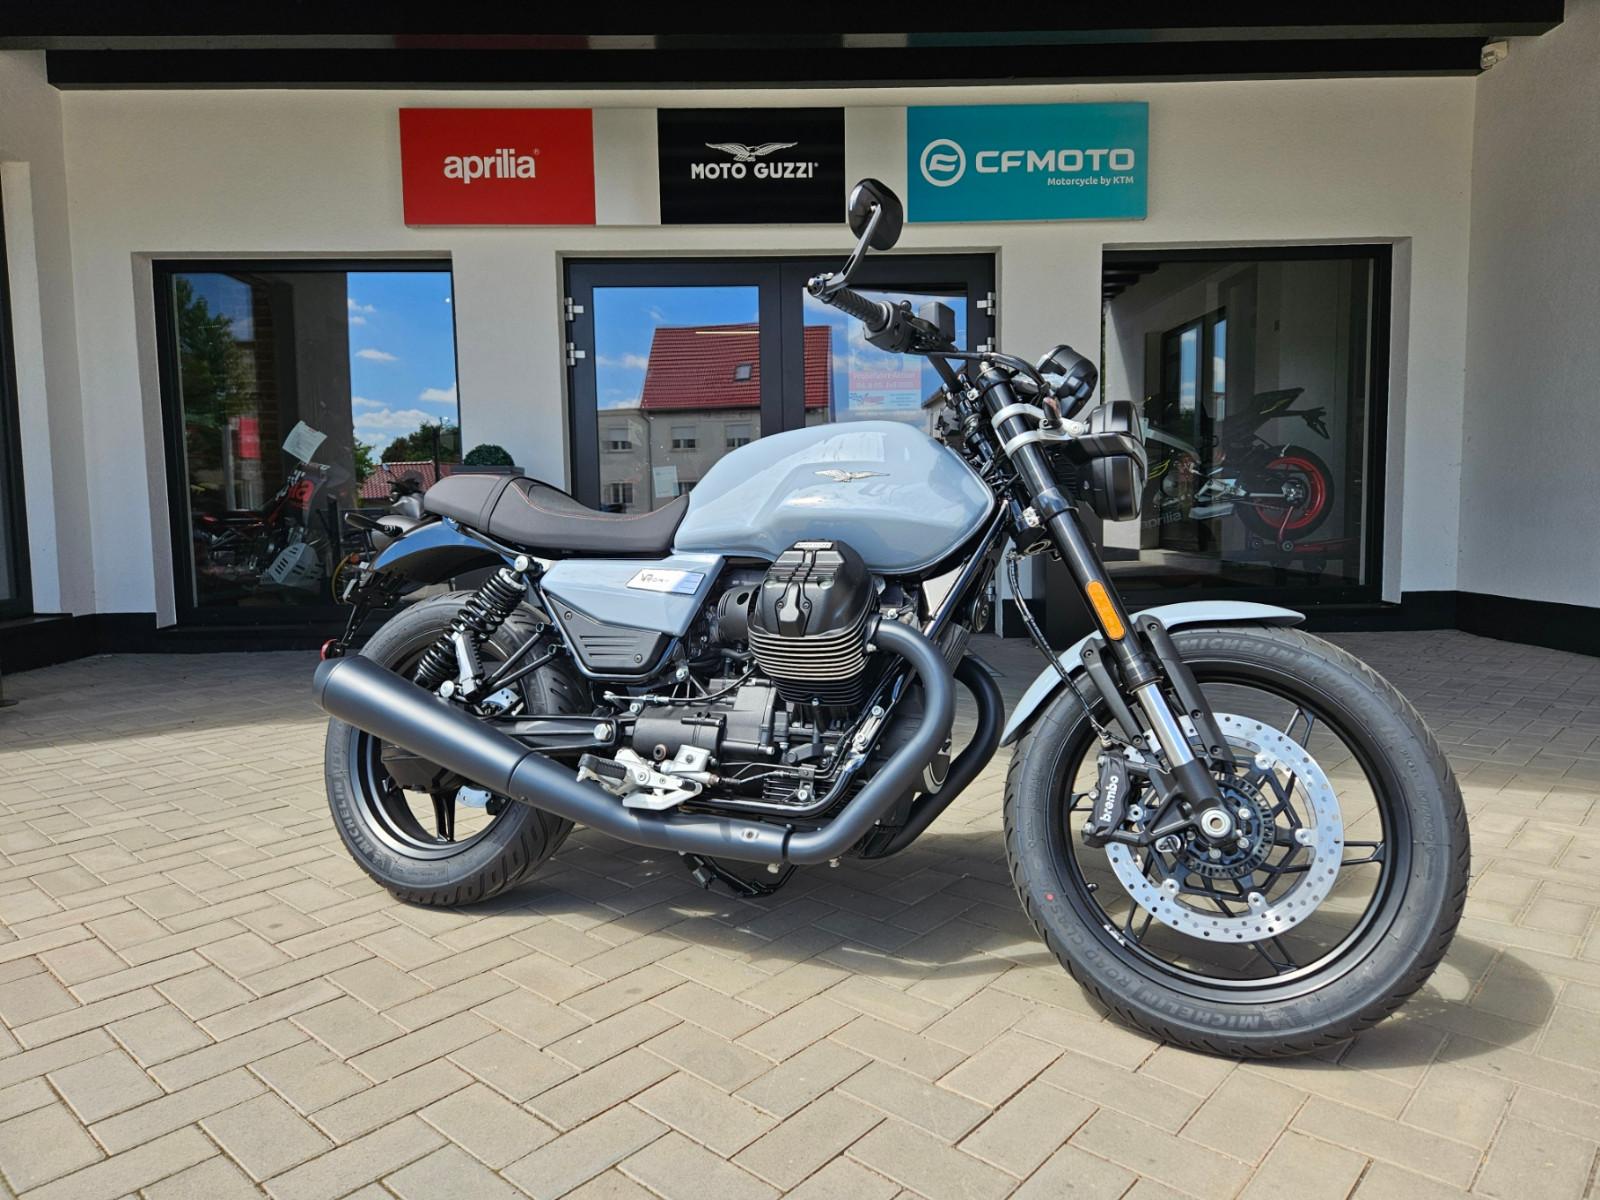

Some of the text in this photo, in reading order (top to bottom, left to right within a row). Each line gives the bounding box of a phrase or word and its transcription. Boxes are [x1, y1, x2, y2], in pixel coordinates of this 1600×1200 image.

[444, 148, 536, 184] aprilia
[691, 162, 814, 180] MOTO GUZZI
[975, 148, 1136, 173] CFMOTO
[1047, 175, 1134, 187] Motorcycle by KTM
[1100, 775, 1119, 822] brembo
[334, 781, 374, 855] MICHELIN
[1085, 950, 1132, 988] ROAD
[1139, 988, 1260, 1028] MICHELIN
